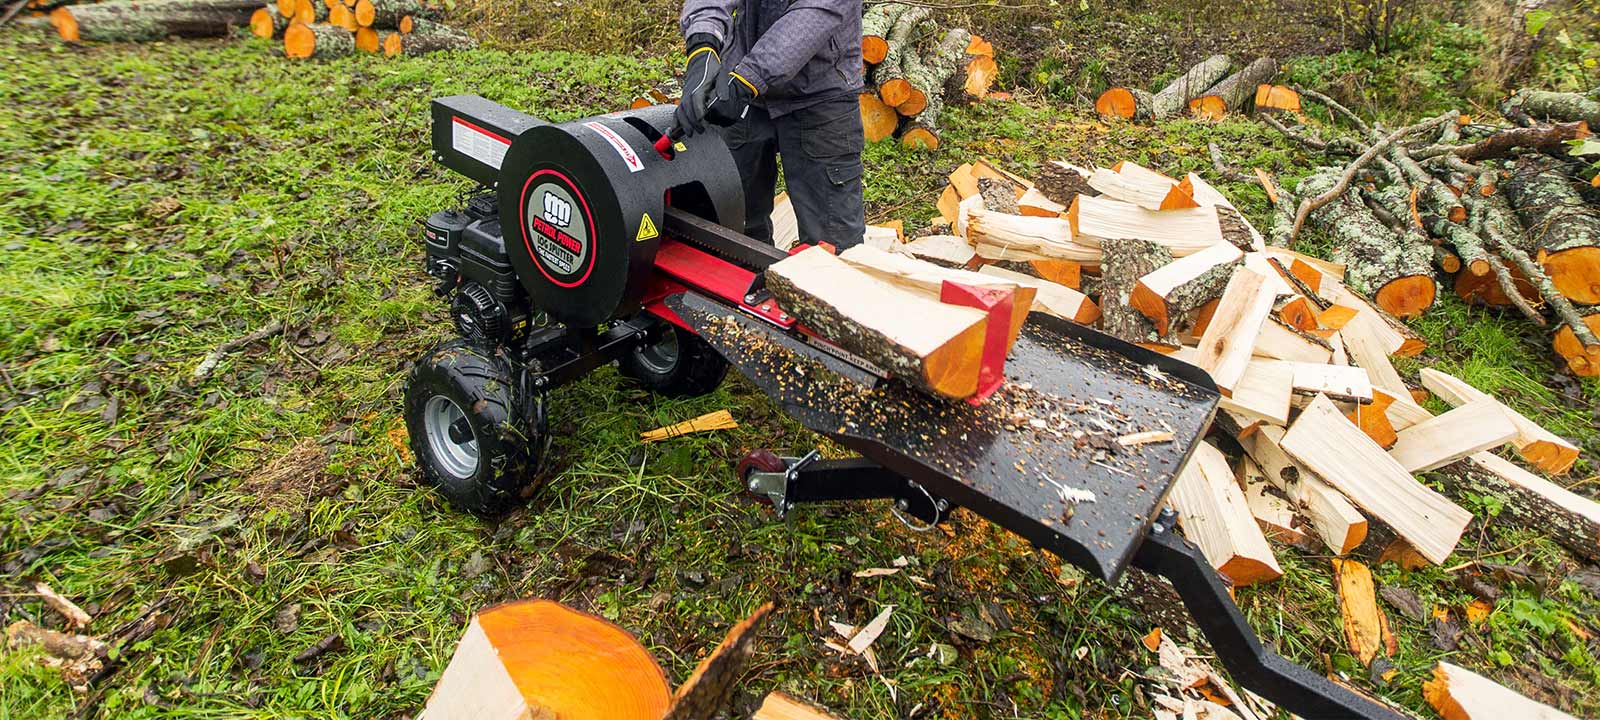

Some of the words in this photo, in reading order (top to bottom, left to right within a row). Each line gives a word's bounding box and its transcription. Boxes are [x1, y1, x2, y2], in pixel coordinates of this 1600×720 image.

[533, 217, 556, 240] PETROL
[557, 231, 581, 254] POWER
[537, 235, 548, 249] LOG
[549, 242, 574, 265] SPLITTER
